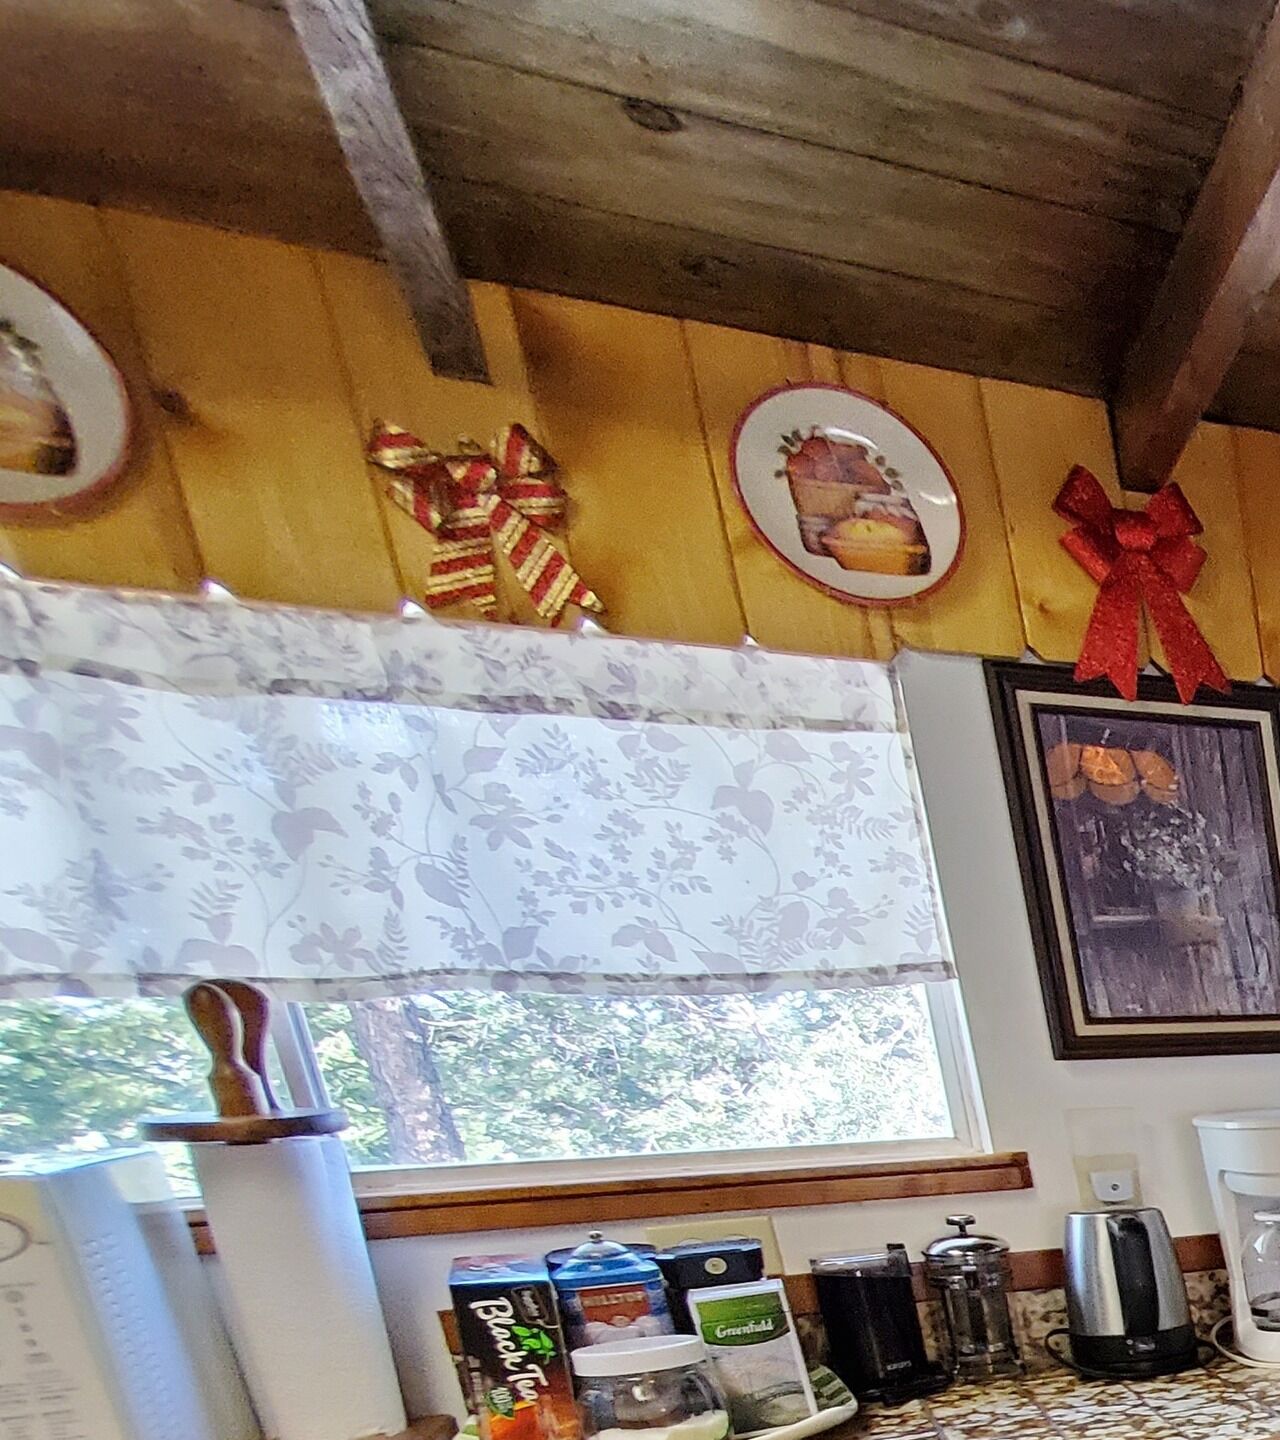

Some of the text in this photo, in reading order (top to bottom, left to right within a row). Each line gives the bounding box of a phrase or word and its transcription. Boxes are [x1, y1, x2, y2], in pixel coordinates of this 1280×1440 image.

[468, 1296, 528, 1371] Black
[507, 1363, 549, 1406] Tea
[714, 1317, 775, 1339] Greenfield
